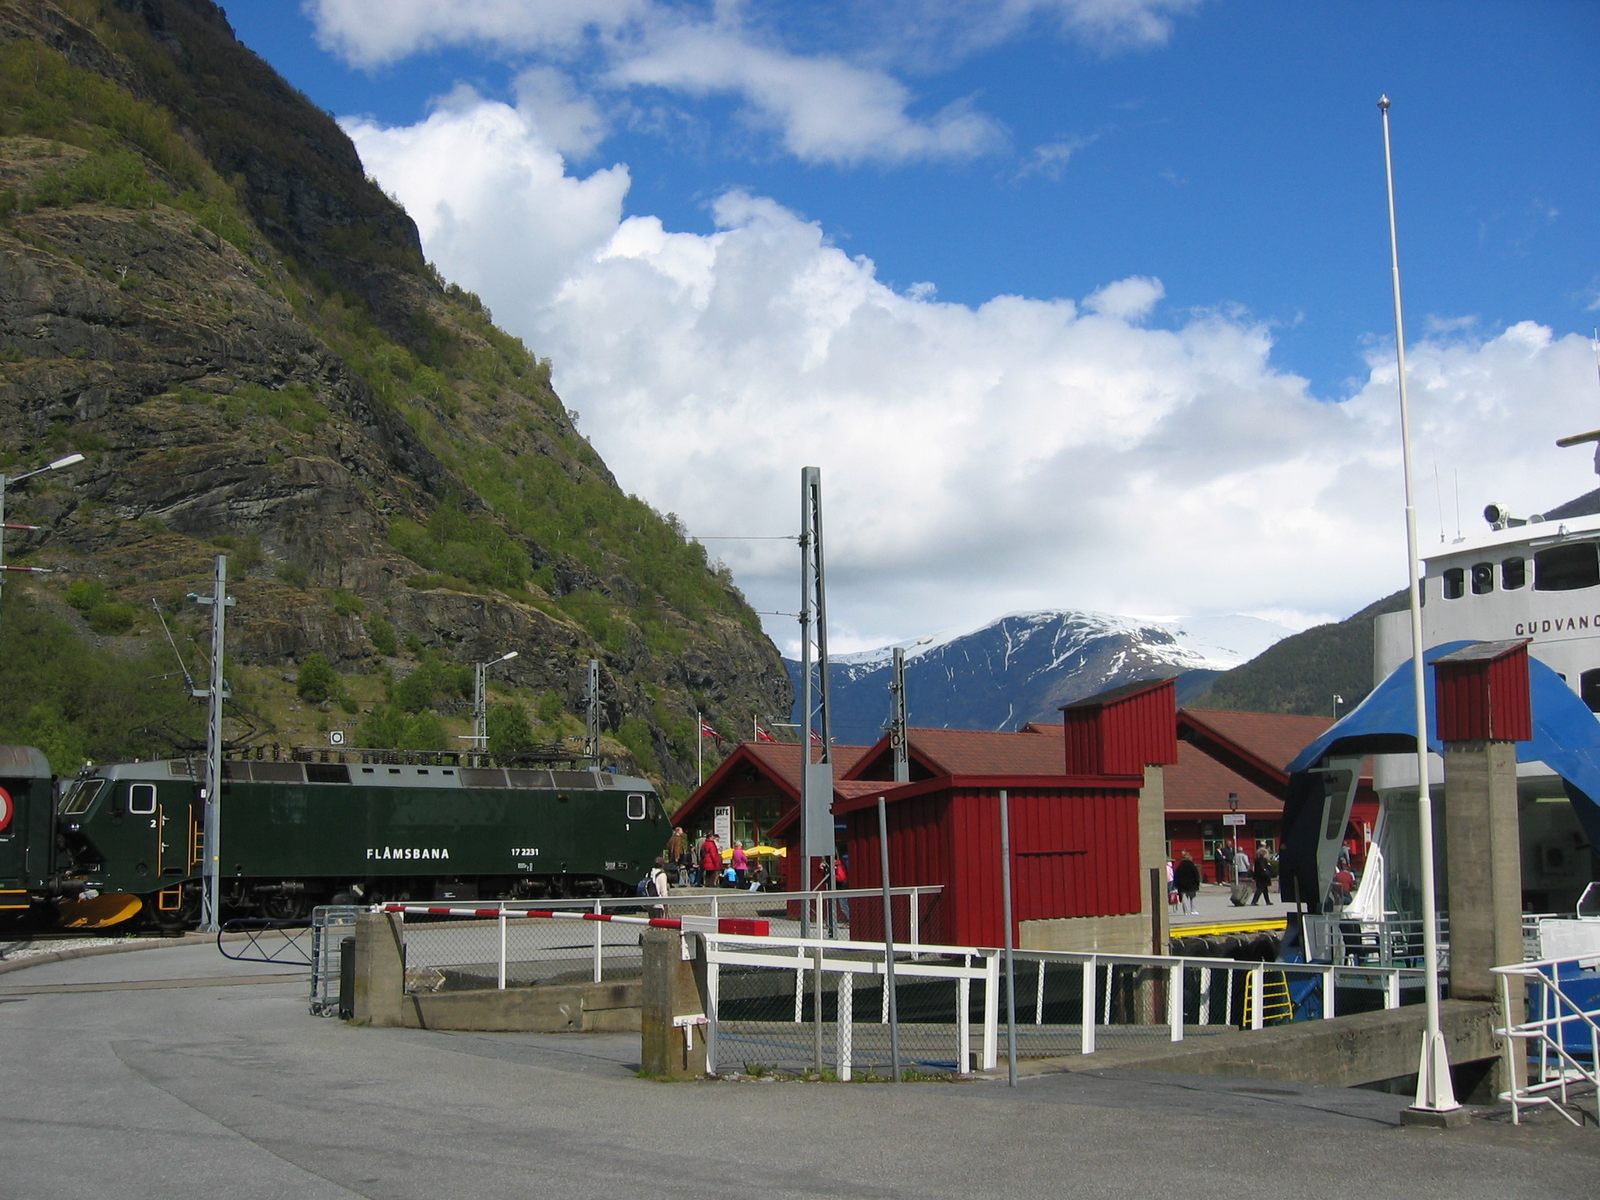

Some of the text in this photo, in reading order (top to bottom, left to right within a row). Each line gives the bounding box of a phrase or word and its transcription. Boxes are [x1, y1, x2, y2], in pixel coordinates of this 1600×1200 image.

[150, 819, 157, 828] 2
[625, 823, 630, 831] 1
[366, 846, 450, 860] FLÅMSBANA
[521, 848, 539, 856] 2231
